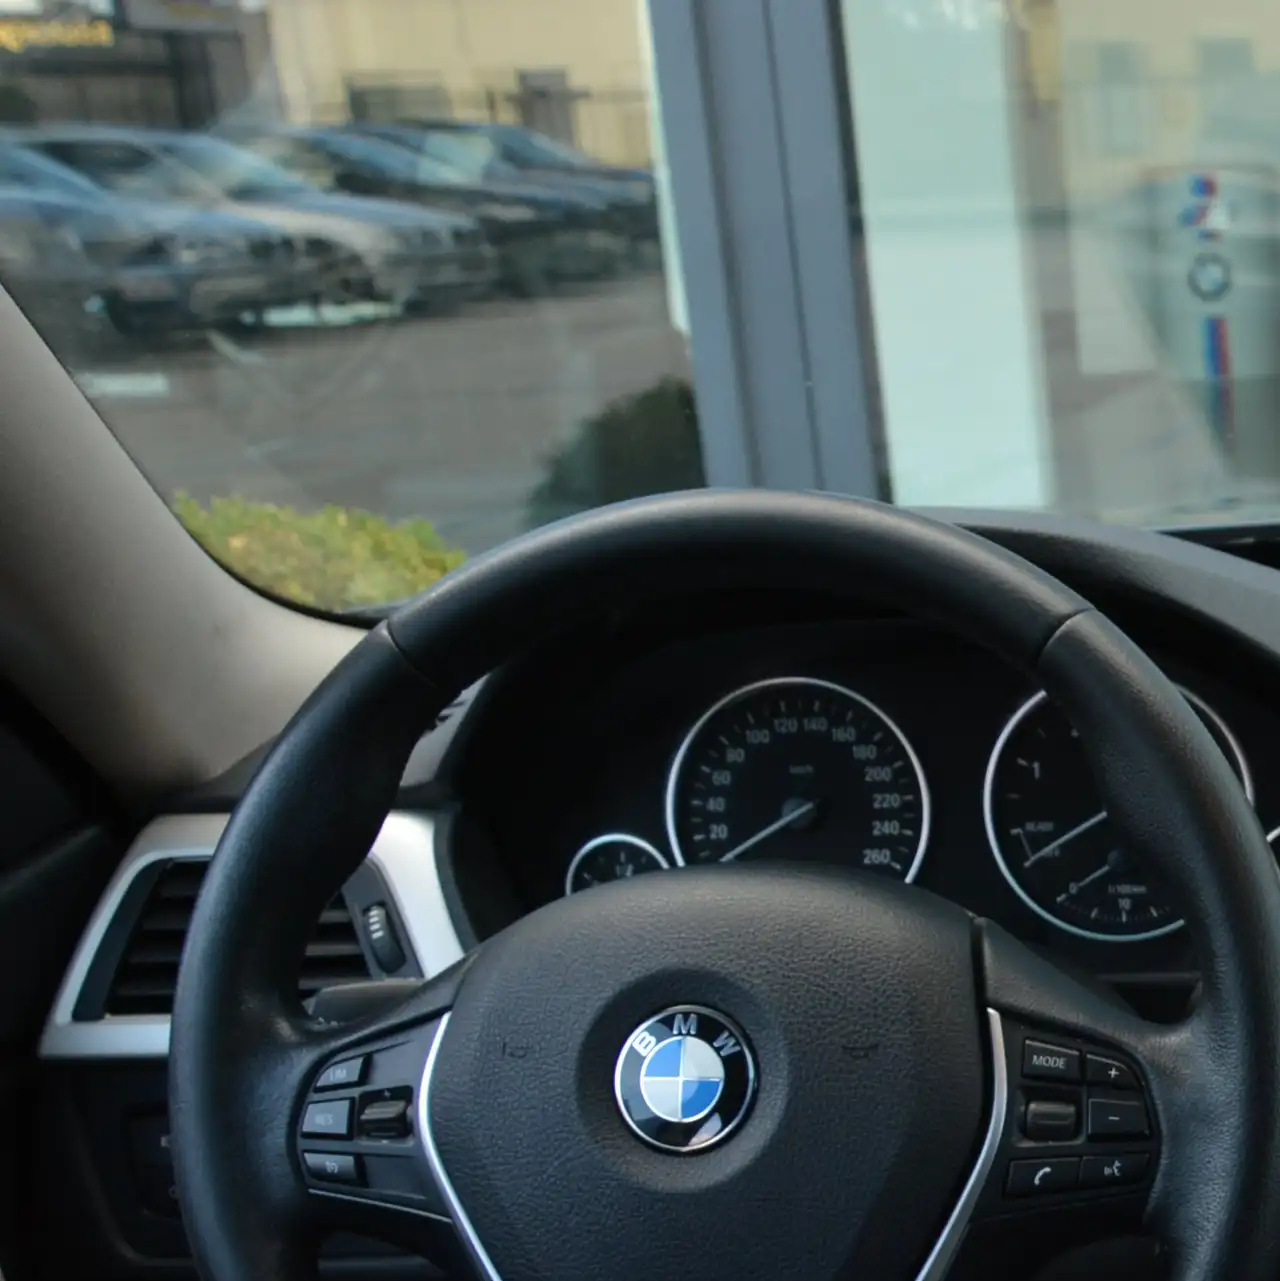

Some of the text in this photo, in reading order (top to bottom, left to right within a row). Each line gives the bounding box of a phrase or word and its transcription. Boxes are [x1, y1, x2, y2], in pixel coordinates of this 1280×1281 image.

[773, 717, 798, 733] 120
[802, 716, 829, 732] 140
[745, 728, 770, 744] 100
[711, 769, 732, 786] 60
[864, 765, 892, 782] 200
[1031, 761, 1041, 779] 1
[705, 796, 726, 813] 40
[872, 792, 901, 809] 220
[708, 823, 728, 840] 20
[872, 820, 900, 837] 240
[862, 848, 891, 864] 260
[632, 1013, 741, 1057] BMW
[1031, 1054, 1066, 1069] MODE
